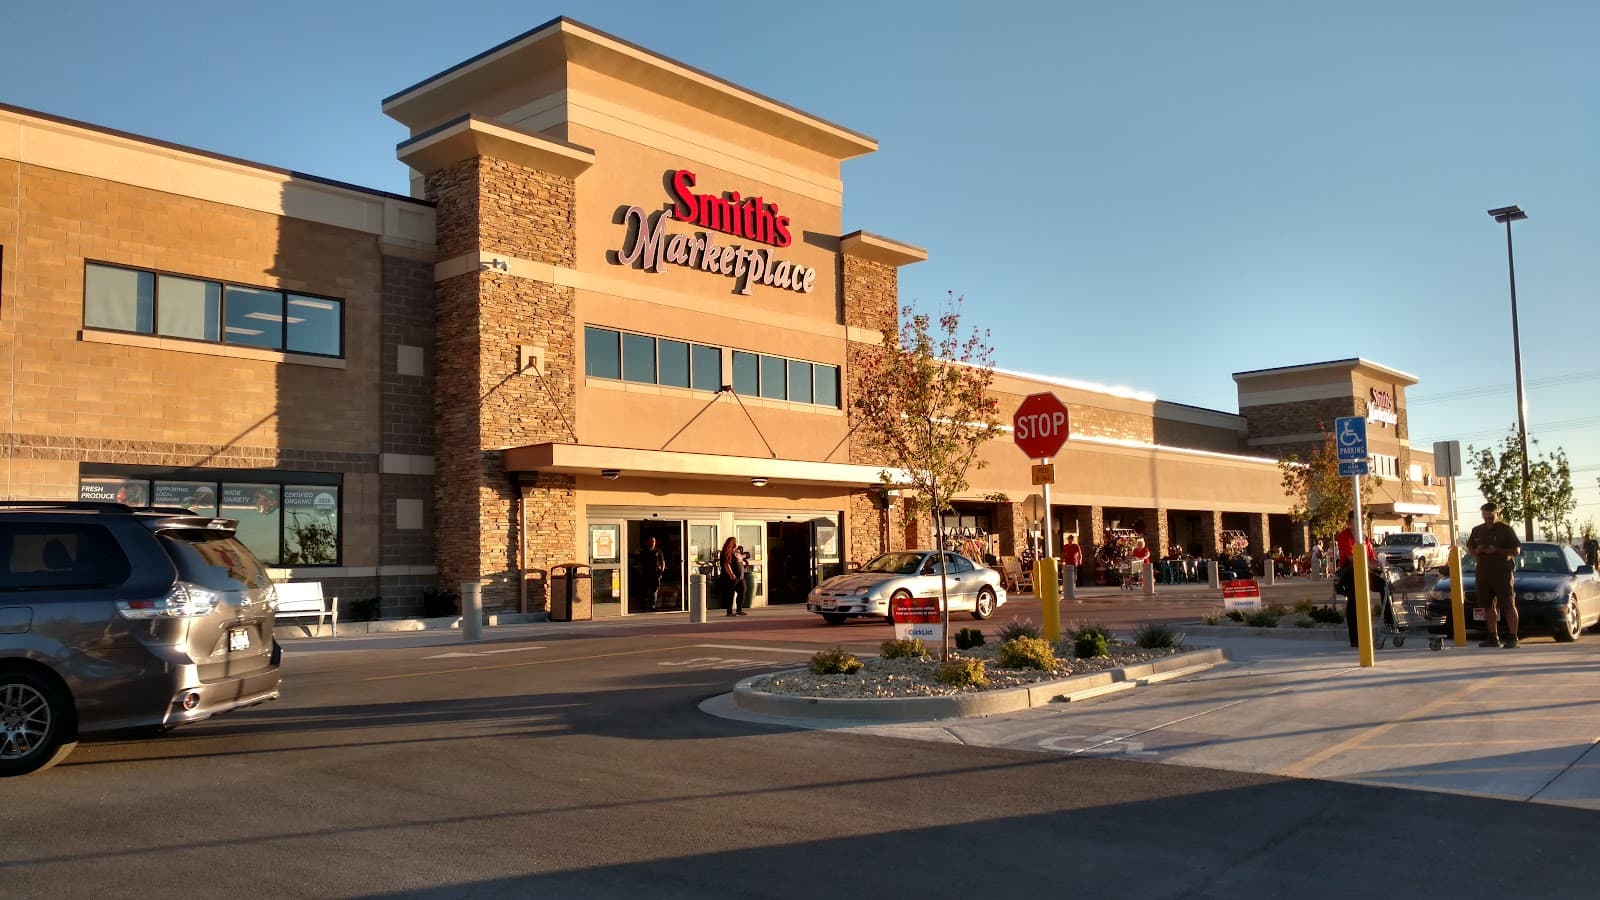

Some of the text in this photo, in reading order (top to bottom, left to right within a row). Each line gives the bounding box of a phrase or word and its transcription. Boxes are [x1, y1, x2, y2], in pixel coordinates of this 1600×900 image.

[673, 169, 792, 247] Smith's
[618, 205, 817, 296] Marketplace
[1017, 411, 1065, 440] STOP
[1339, 446, 1365, 455] PARKING
